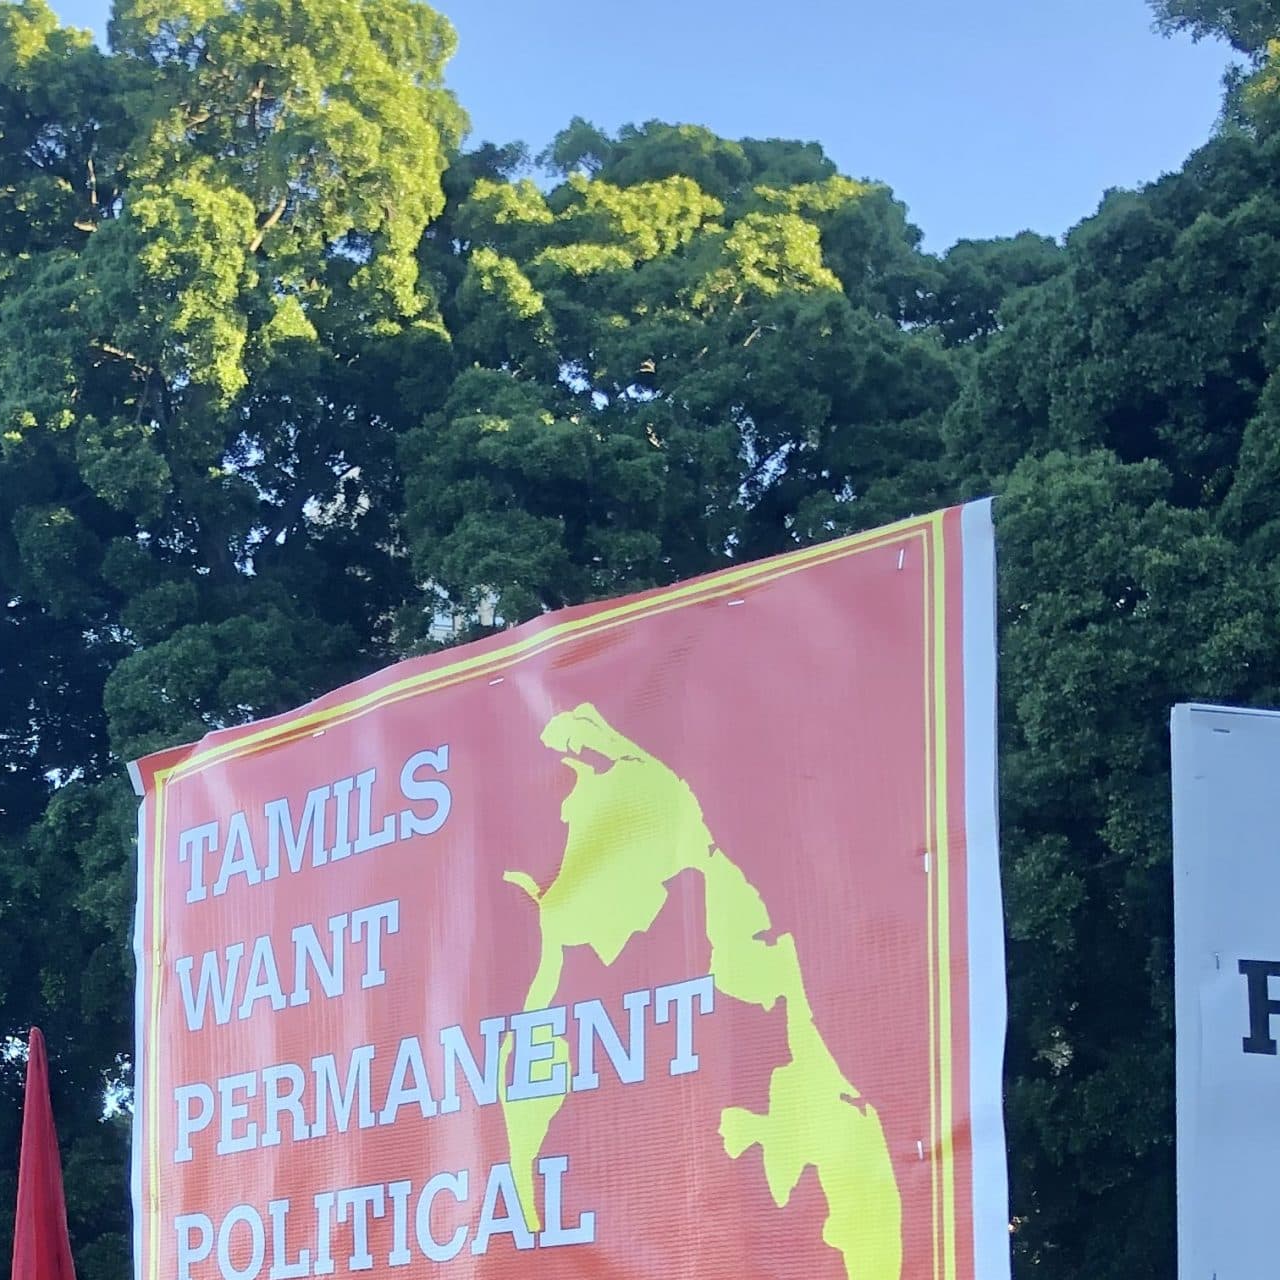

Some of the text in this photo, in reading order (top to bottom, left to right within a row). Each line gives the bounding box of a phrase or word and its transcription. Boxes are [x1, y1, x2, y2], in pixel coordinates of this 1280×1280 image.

[179, 744, 453, 904] TAMILS
[176, 899, 400, 1031] WANT
[174, 975, 716, 1163] PERMANENT
